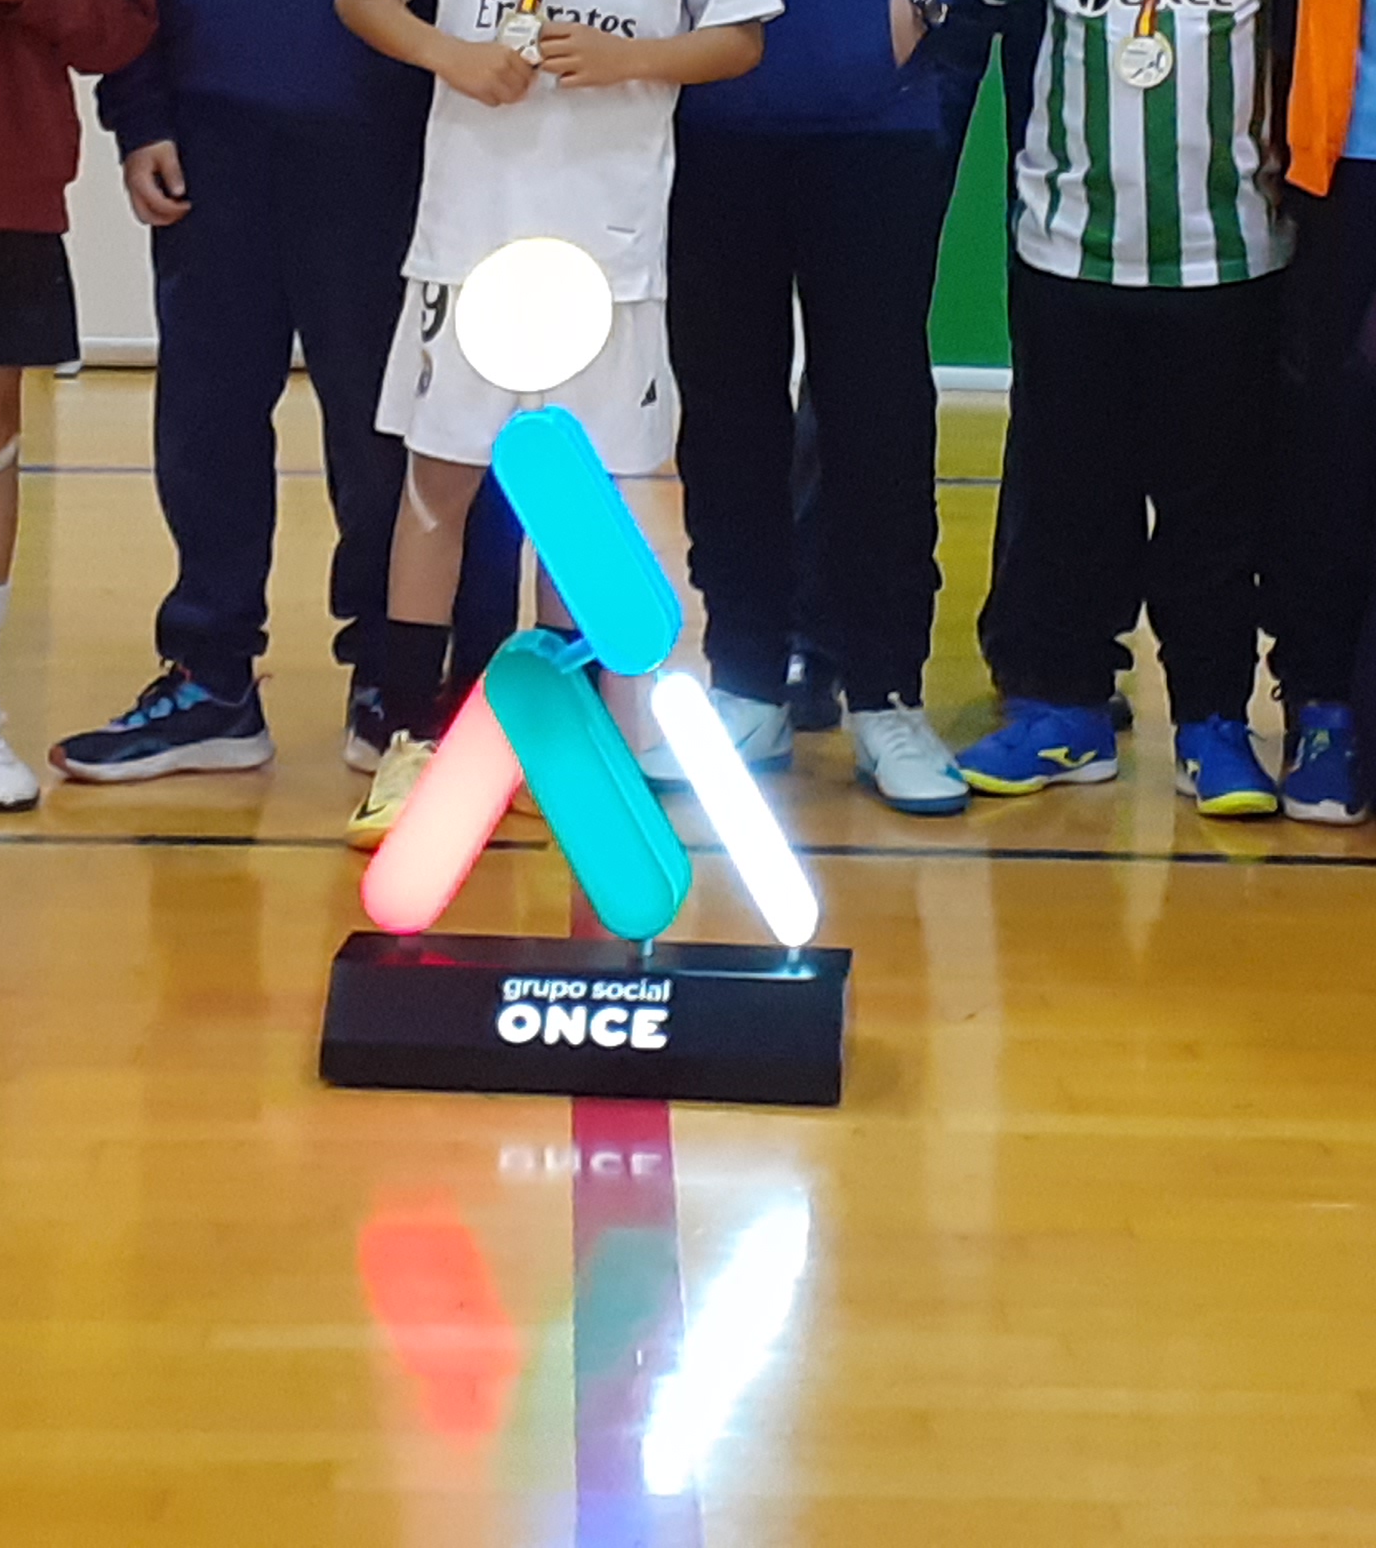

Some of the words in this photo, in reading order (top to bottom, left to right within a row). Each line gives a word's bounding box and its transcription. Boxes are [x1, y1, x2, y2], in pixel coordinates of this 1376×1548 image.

[502, 978, 587, 1002] grupo
[591, 977, 672, 1002] social
[497, 1003, 669, 1049] ONCE
